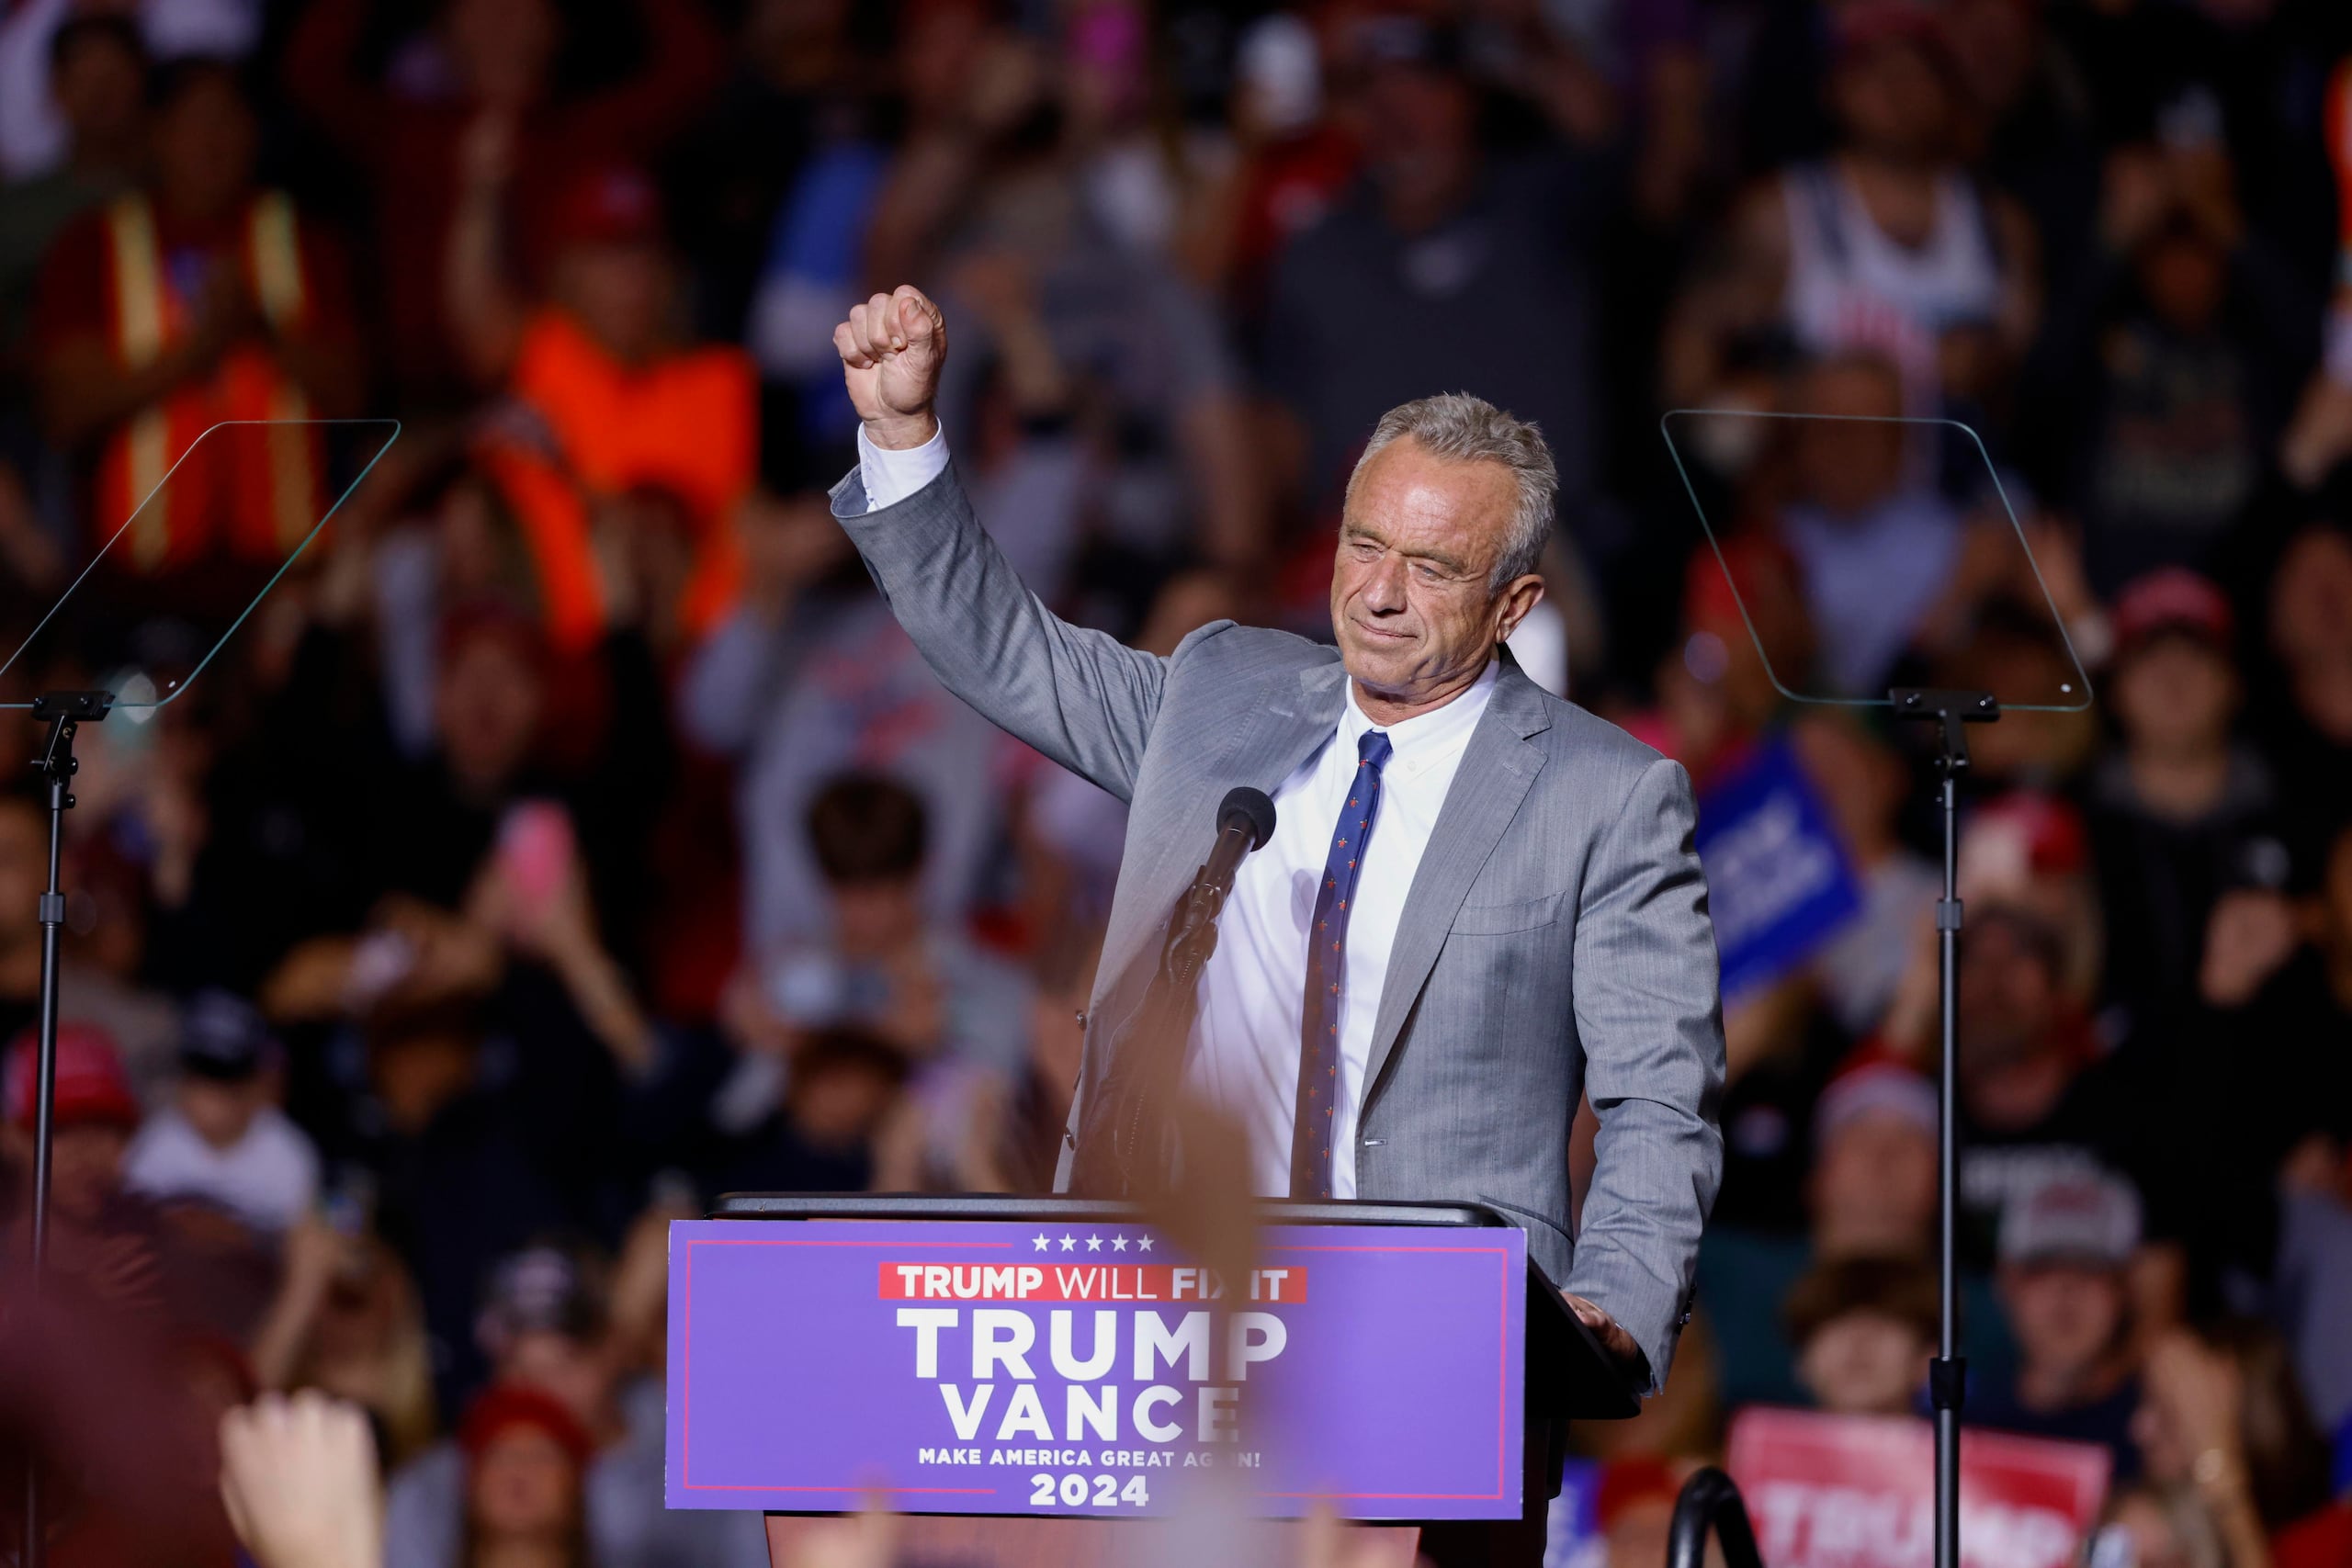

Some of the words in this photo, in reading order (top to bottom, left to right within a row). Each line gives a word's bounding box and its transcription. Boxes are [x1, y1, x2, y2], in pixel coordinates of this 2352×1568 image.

[897, 1265, 1044, 1299] TRUMP
[1055, 1267, 1158, 1300] WILL
[1250, 1269, 1288, 1301] IT
[896, 1307, 1287, 1382] TRUMP
[939, 1383, 1239, 1443] VANCE
[919, 1448, 981, 1465] MAKE
[989, 1449, 1092, 1466] AMERICA
[1100, 1450, 1175, 1467] GREAT
[1182, 1451, 1261, 1468] AGN!
[1029, 1472, 1149, 1507] 2024
